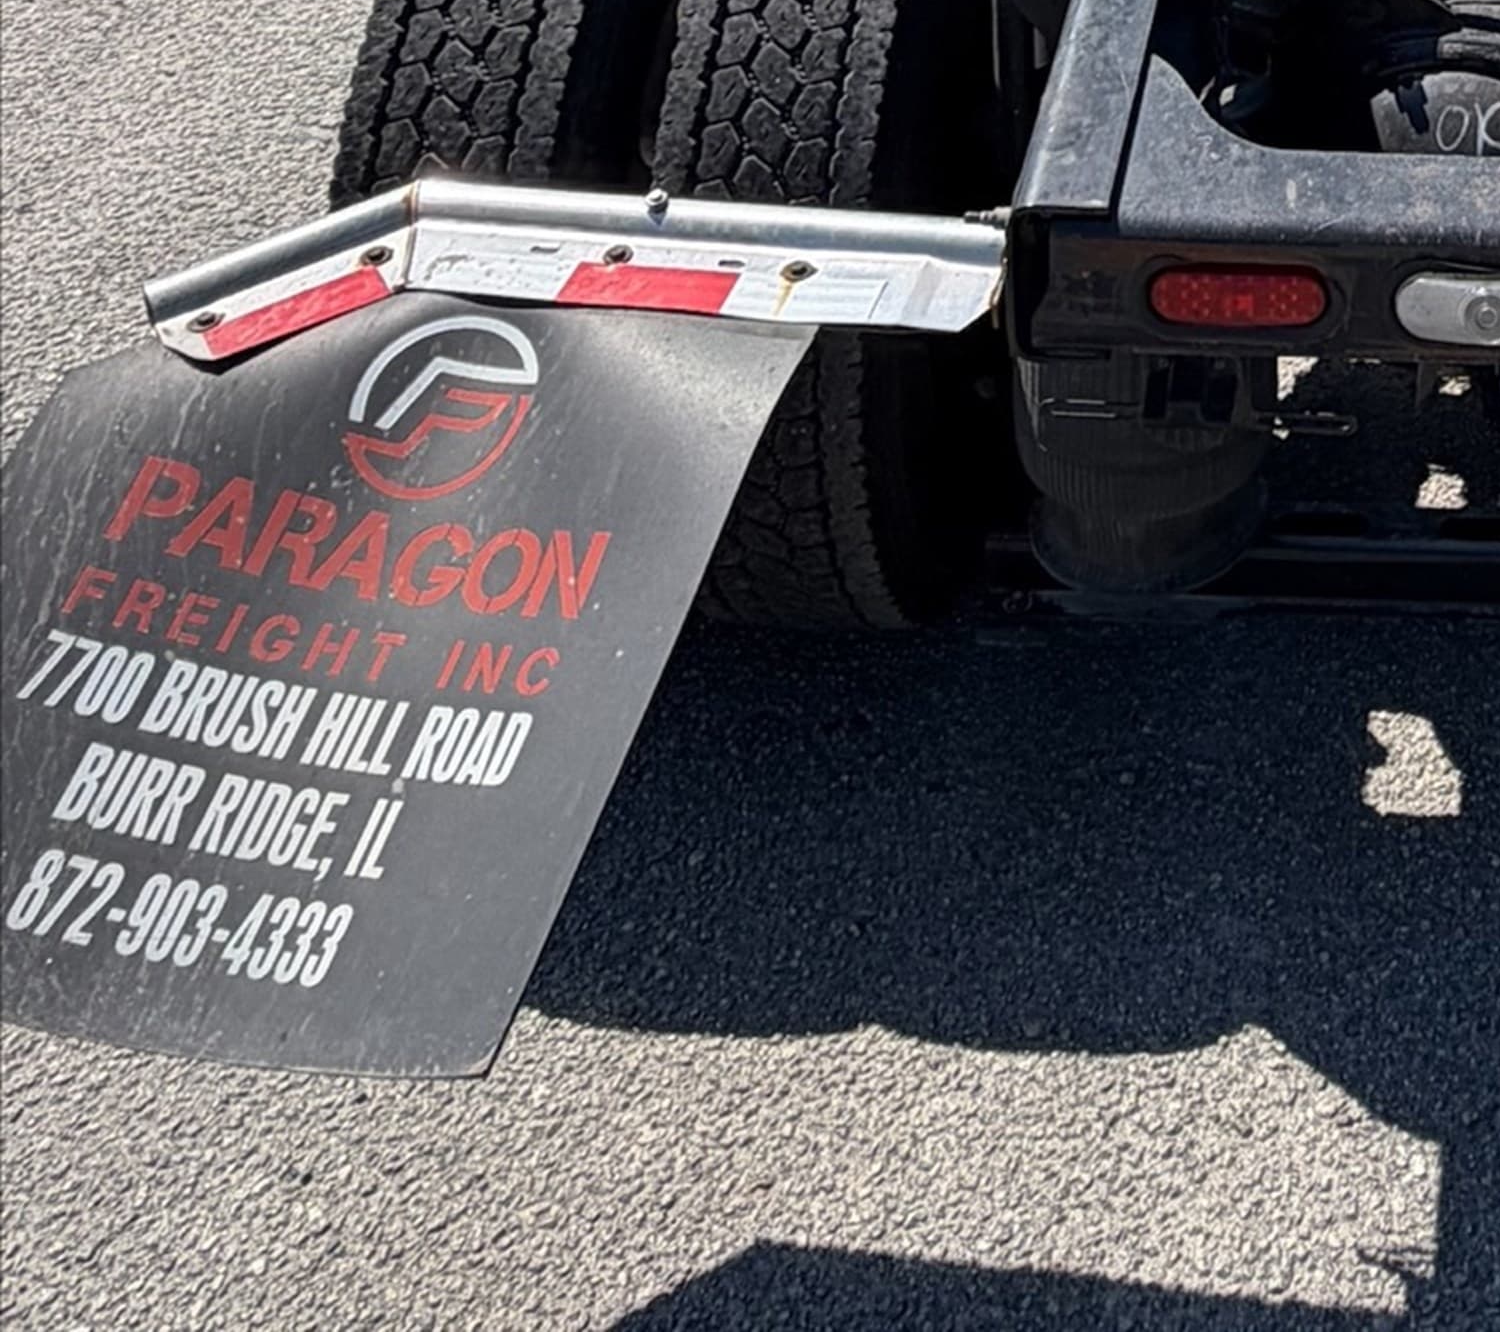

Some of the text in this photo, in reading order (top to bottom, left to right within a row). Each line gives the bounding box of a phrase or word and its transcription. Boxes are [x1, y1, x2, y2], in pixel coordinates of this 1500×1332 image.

[104, 455, 611, 620] PARAGON
[60, 565, 560, 699] FREIGHT INC
[16, 630, 533, 786] 7700 BRUSH HILL ROAD
[52, 742, 403, 881] BURR RIDGE, IL
[6, 849, 353, 987] 872-903-4333
